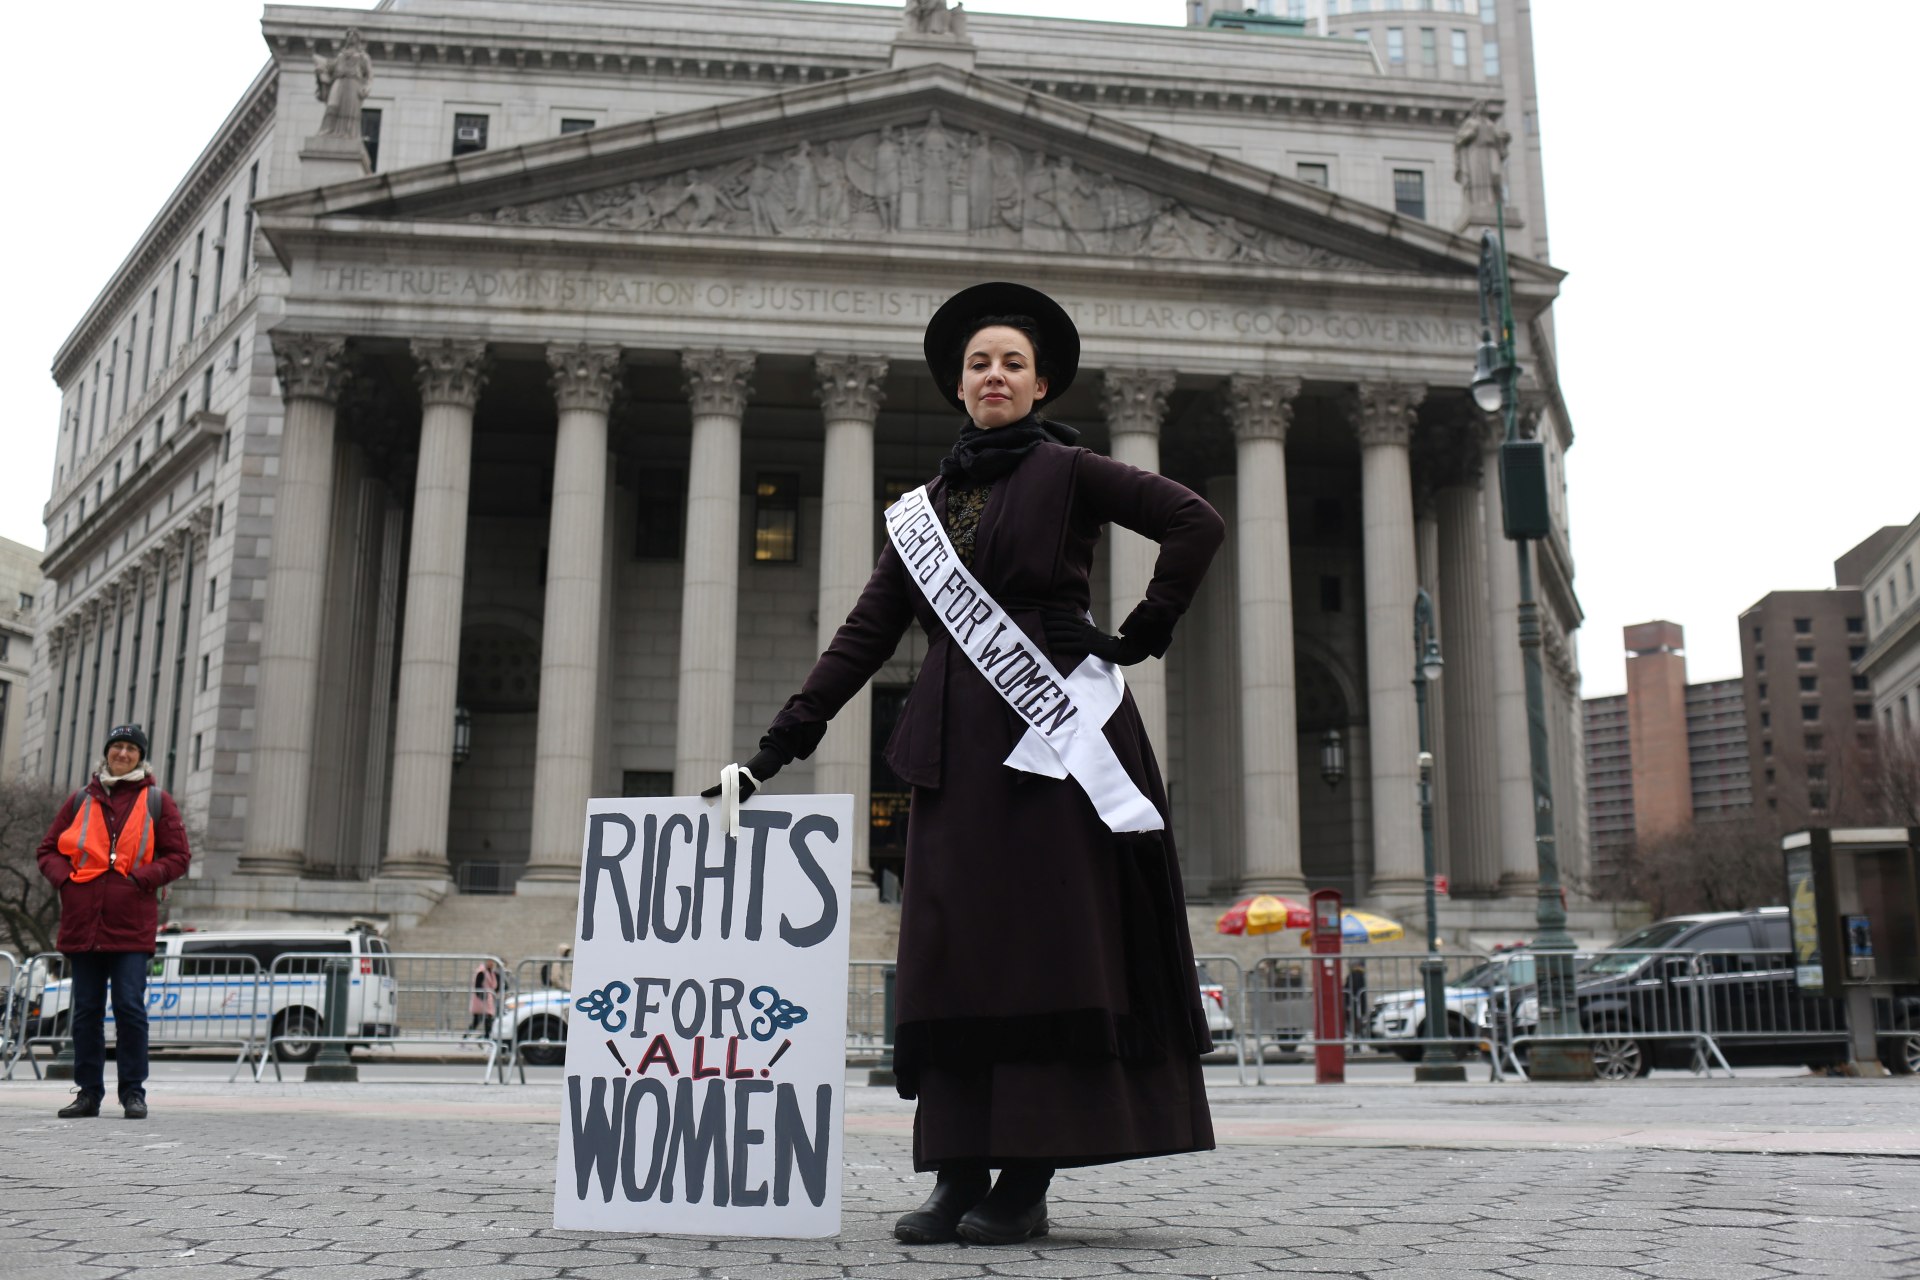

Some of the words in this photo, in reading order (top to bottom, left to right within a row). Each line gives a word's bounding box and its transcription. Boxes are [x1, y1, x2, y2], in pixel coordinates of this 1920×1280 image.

[320, 266, 374, 291] THE
[382, 268, 451, 295] TRUE
[461, 270, 697, 306] ADMINISTRATION
[706, 283, 748, 309] OF
[750, 286, 867, 314] JUSTICE
[879, 291, 902, 316] IS
[911, 293, 950, 319] TH
[1093, 302, 1181, 330] PILLAR
[1185, 307, 1222, 331] OF
[1232, 309, 1313, 336] GOOD
[889, 492, 949, 586] RIGHTS
[932, 566, 993, 645] FOR
[976, 622, 1080, 737] WOMEN
[580, 809, 840, 949] RIGHTS
[629, 976, 749, 1040] FOR
[567, 1075, 833, 1208] WOMEN
